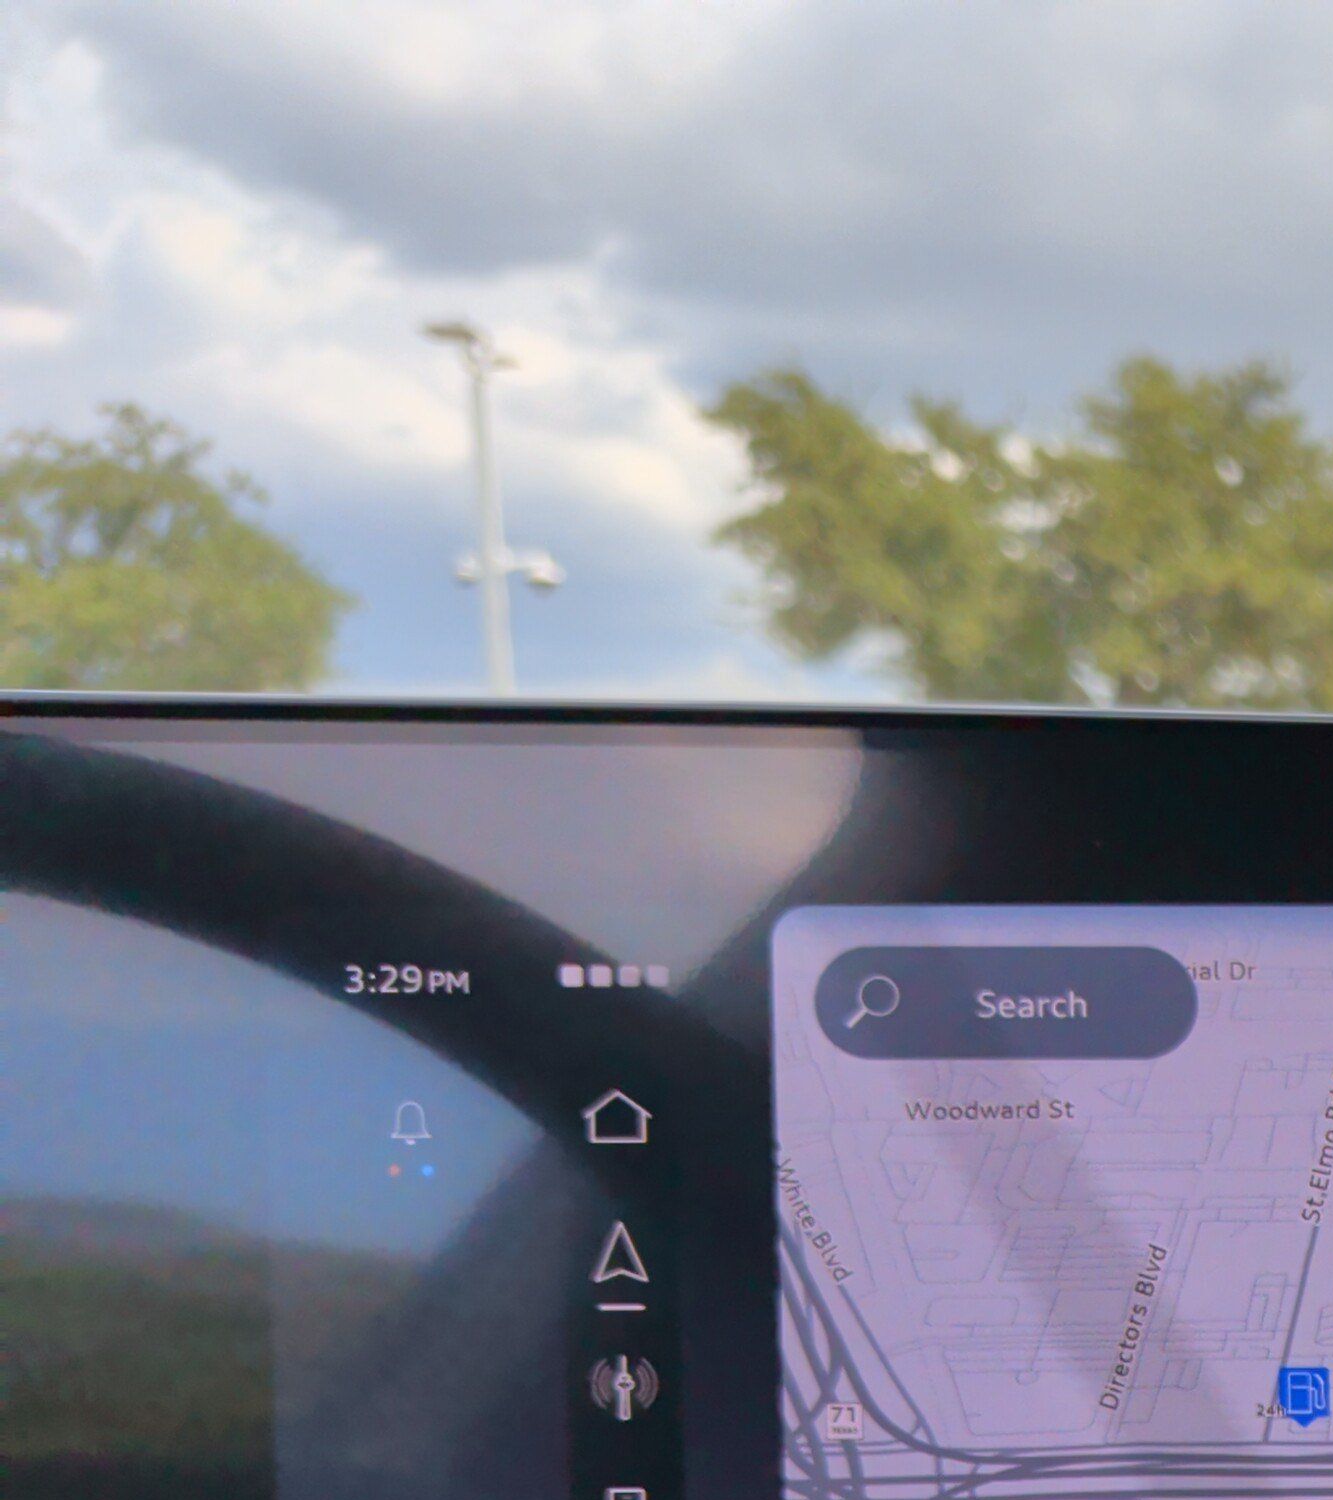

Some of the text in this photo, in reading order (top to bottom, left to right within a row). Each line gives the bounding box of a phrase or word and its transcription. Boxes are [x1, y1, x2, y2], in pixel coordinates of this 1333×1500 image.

[1187, 961, 1258, 980] ial Dr
[975, 991, 1088, 1019] Search
[905, 1099, 1075, 1121] Woodward St
[812, 1230, 853, 1283] Blvd
[1099, 1243, 1167, 1411] Directors Blvd
[831, 1406, 855, 1423] 71
